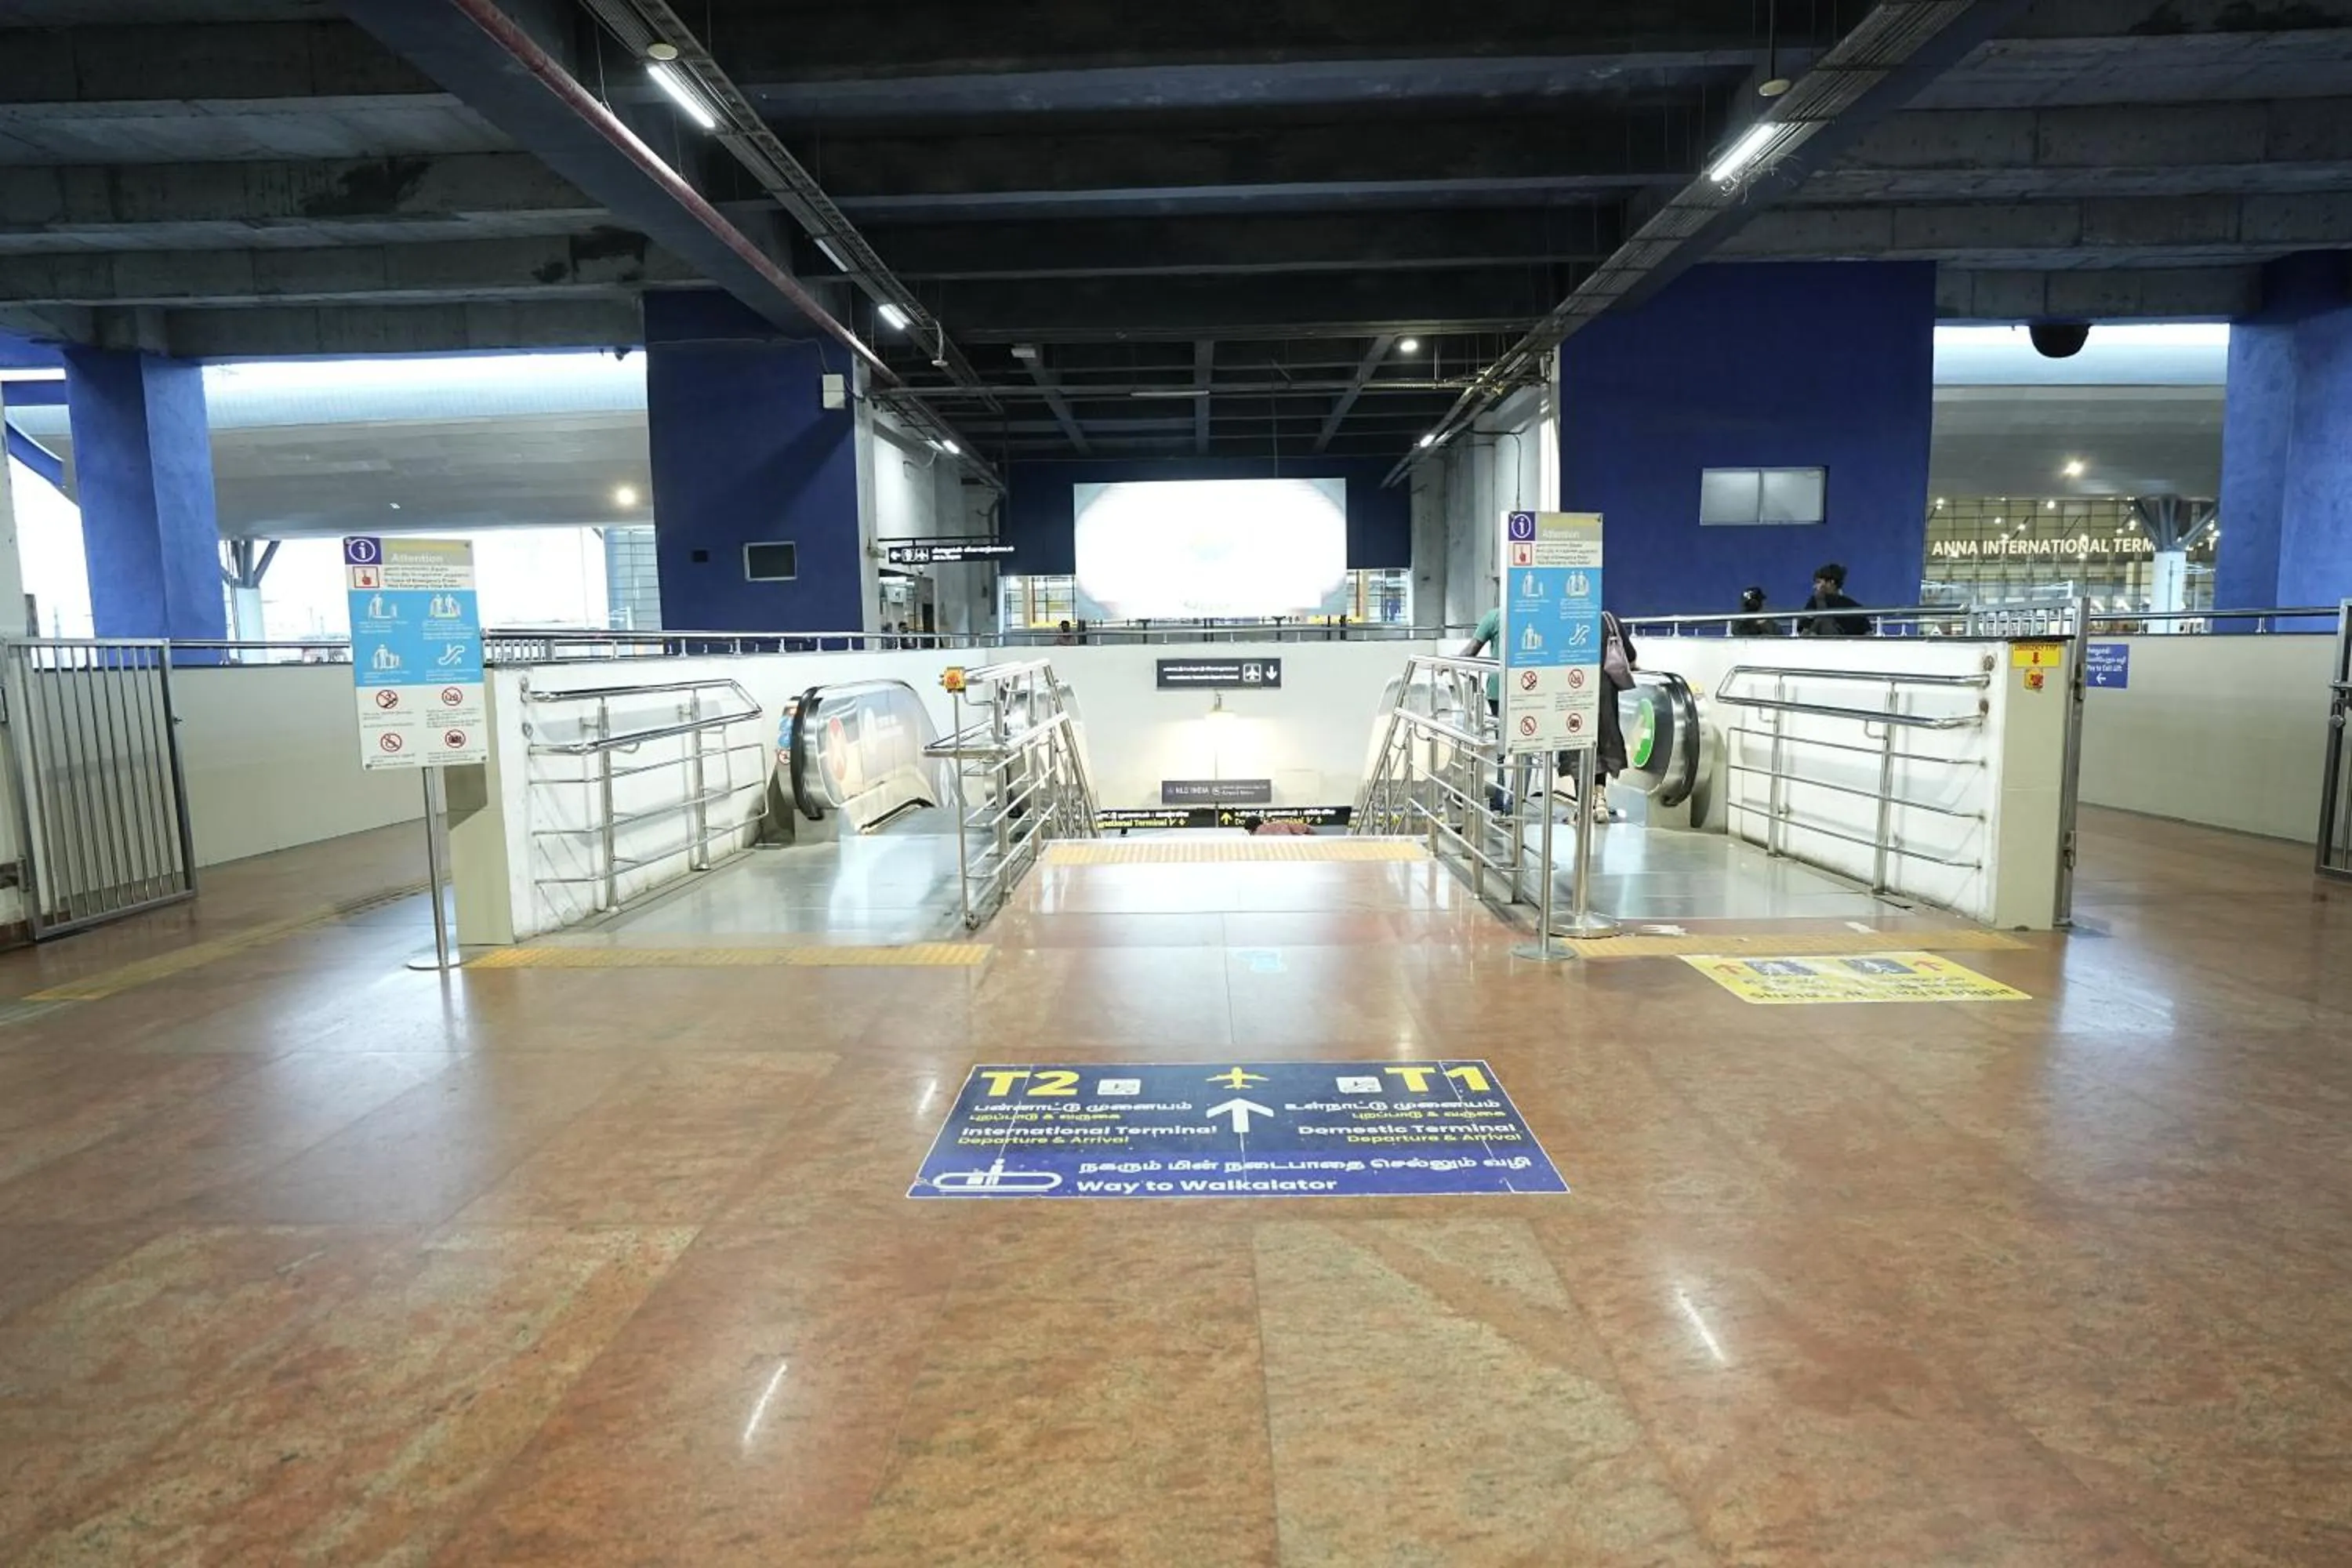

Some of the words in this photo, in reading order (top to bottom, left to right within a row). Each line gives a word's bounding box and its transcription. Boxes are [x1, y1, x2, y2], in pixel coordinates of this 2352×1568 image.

[1932, 541, 1978, 556] ANNA
[1983, 539, 2109, 554] INTERNATIONAL
[981, 1070, 1080, 1096] T2
[1384, 1066, 1490, 1091] T1
[962, 1126, 1110, 1136] International
[1116, 1125, 1218, 1136] Terminal
[1298, 1125, 1407, 1135] Domestic
[1411, 1123, 1516, 1134] Terminal
[957, 1137, 1048, 1145] Departure
[1348, 1134, 1439, 1144] Departure
[1462, 1133, 1523, 1142] Arrival
[1076, 1181, 1140, 1194] Way
[1145, 1180, 1174, 1192] to
[1180, 1178, 1338, 1192] Walkalator
